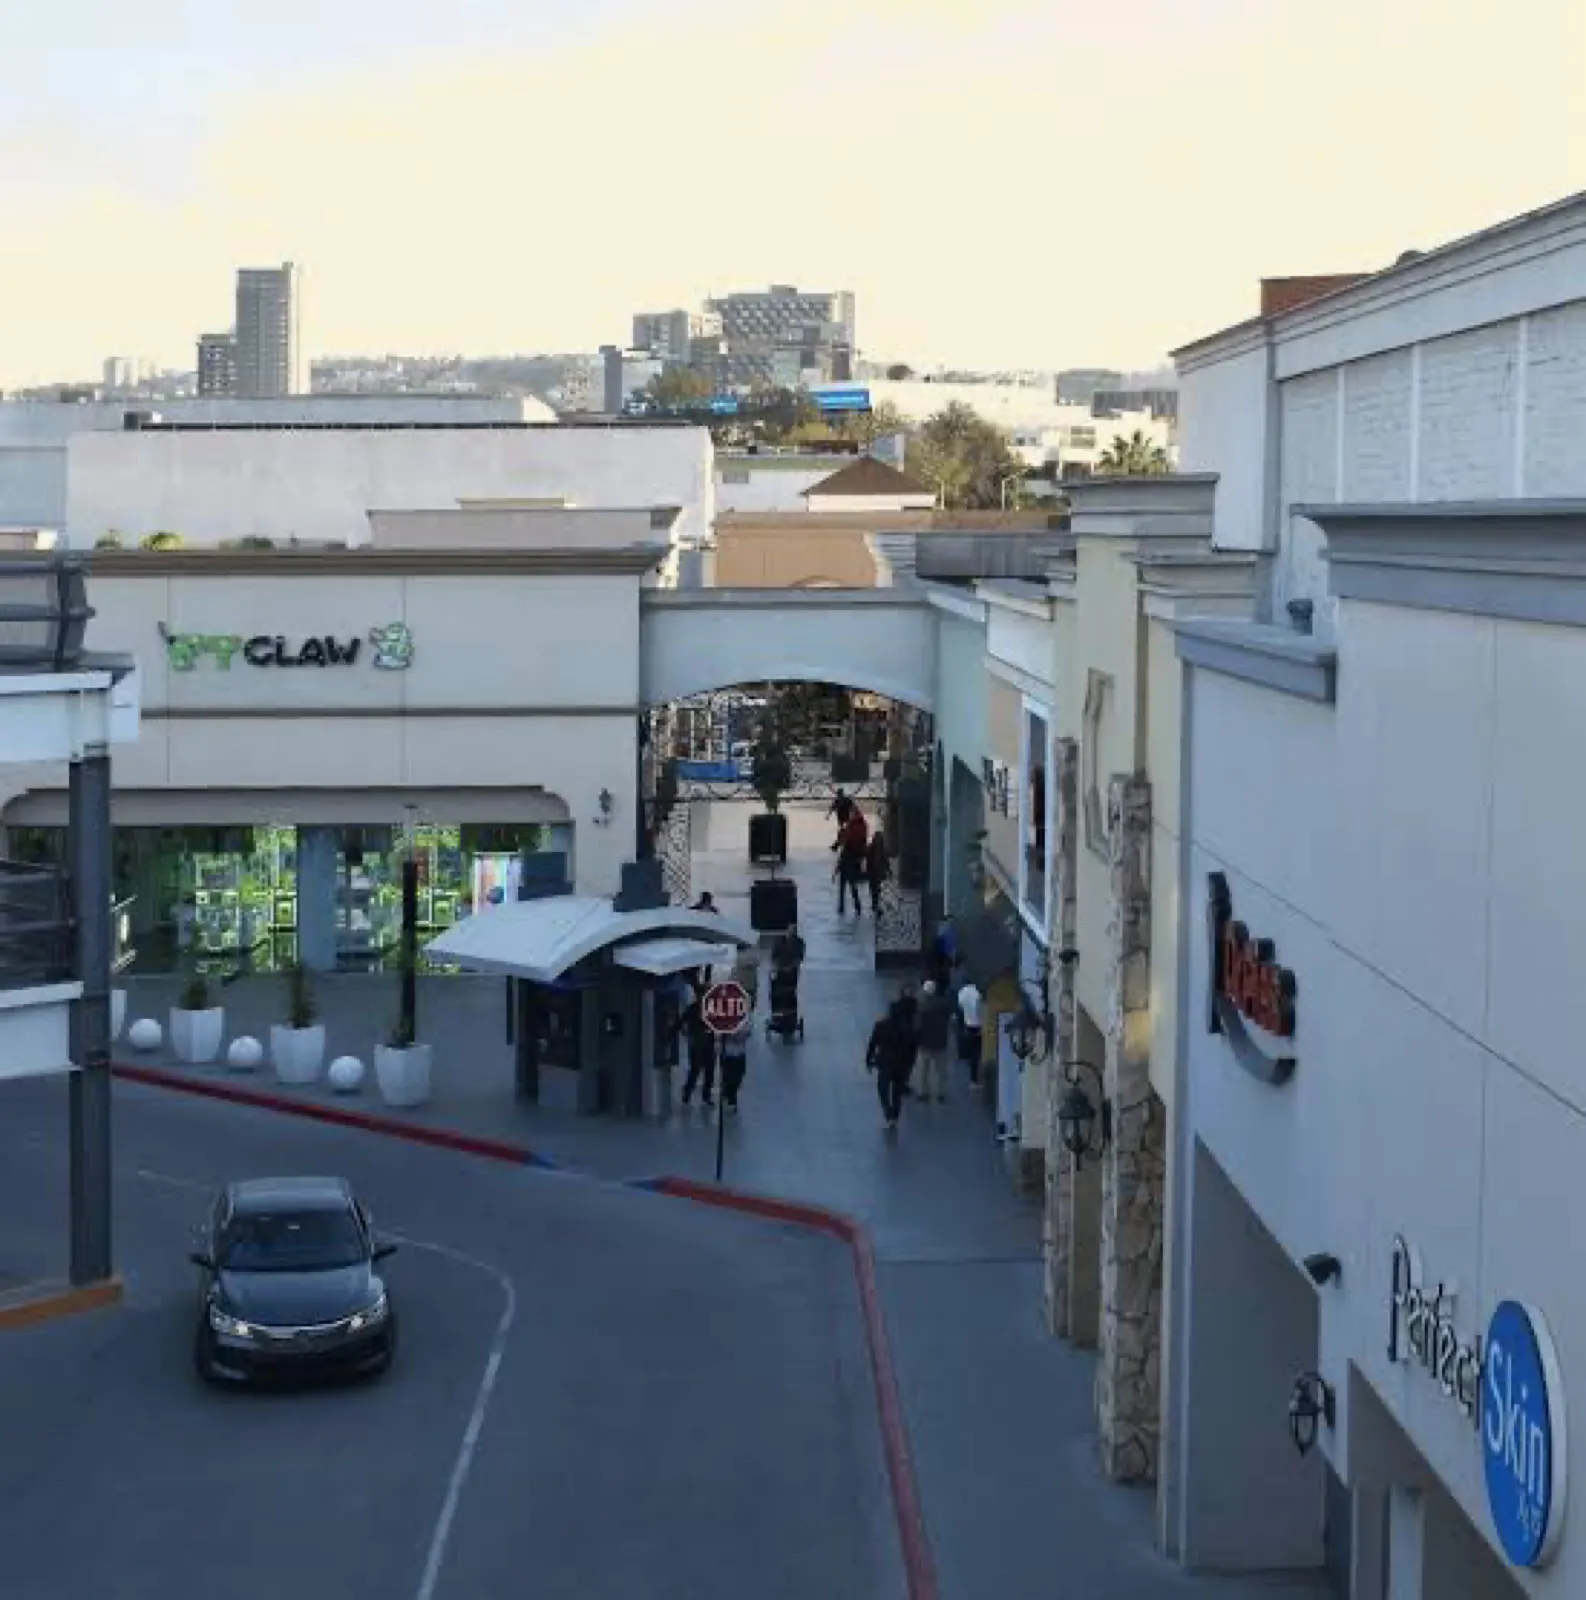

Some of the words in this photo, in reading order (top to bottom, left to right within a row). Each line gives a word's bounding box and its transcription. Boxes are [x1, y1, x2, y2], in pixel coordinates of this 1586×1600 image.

[706, 997, 748, 1017] ALTO
[1388, 1232, 1482, 1430] Perfect
[1486, 1339, 1544, 1505] Skin
